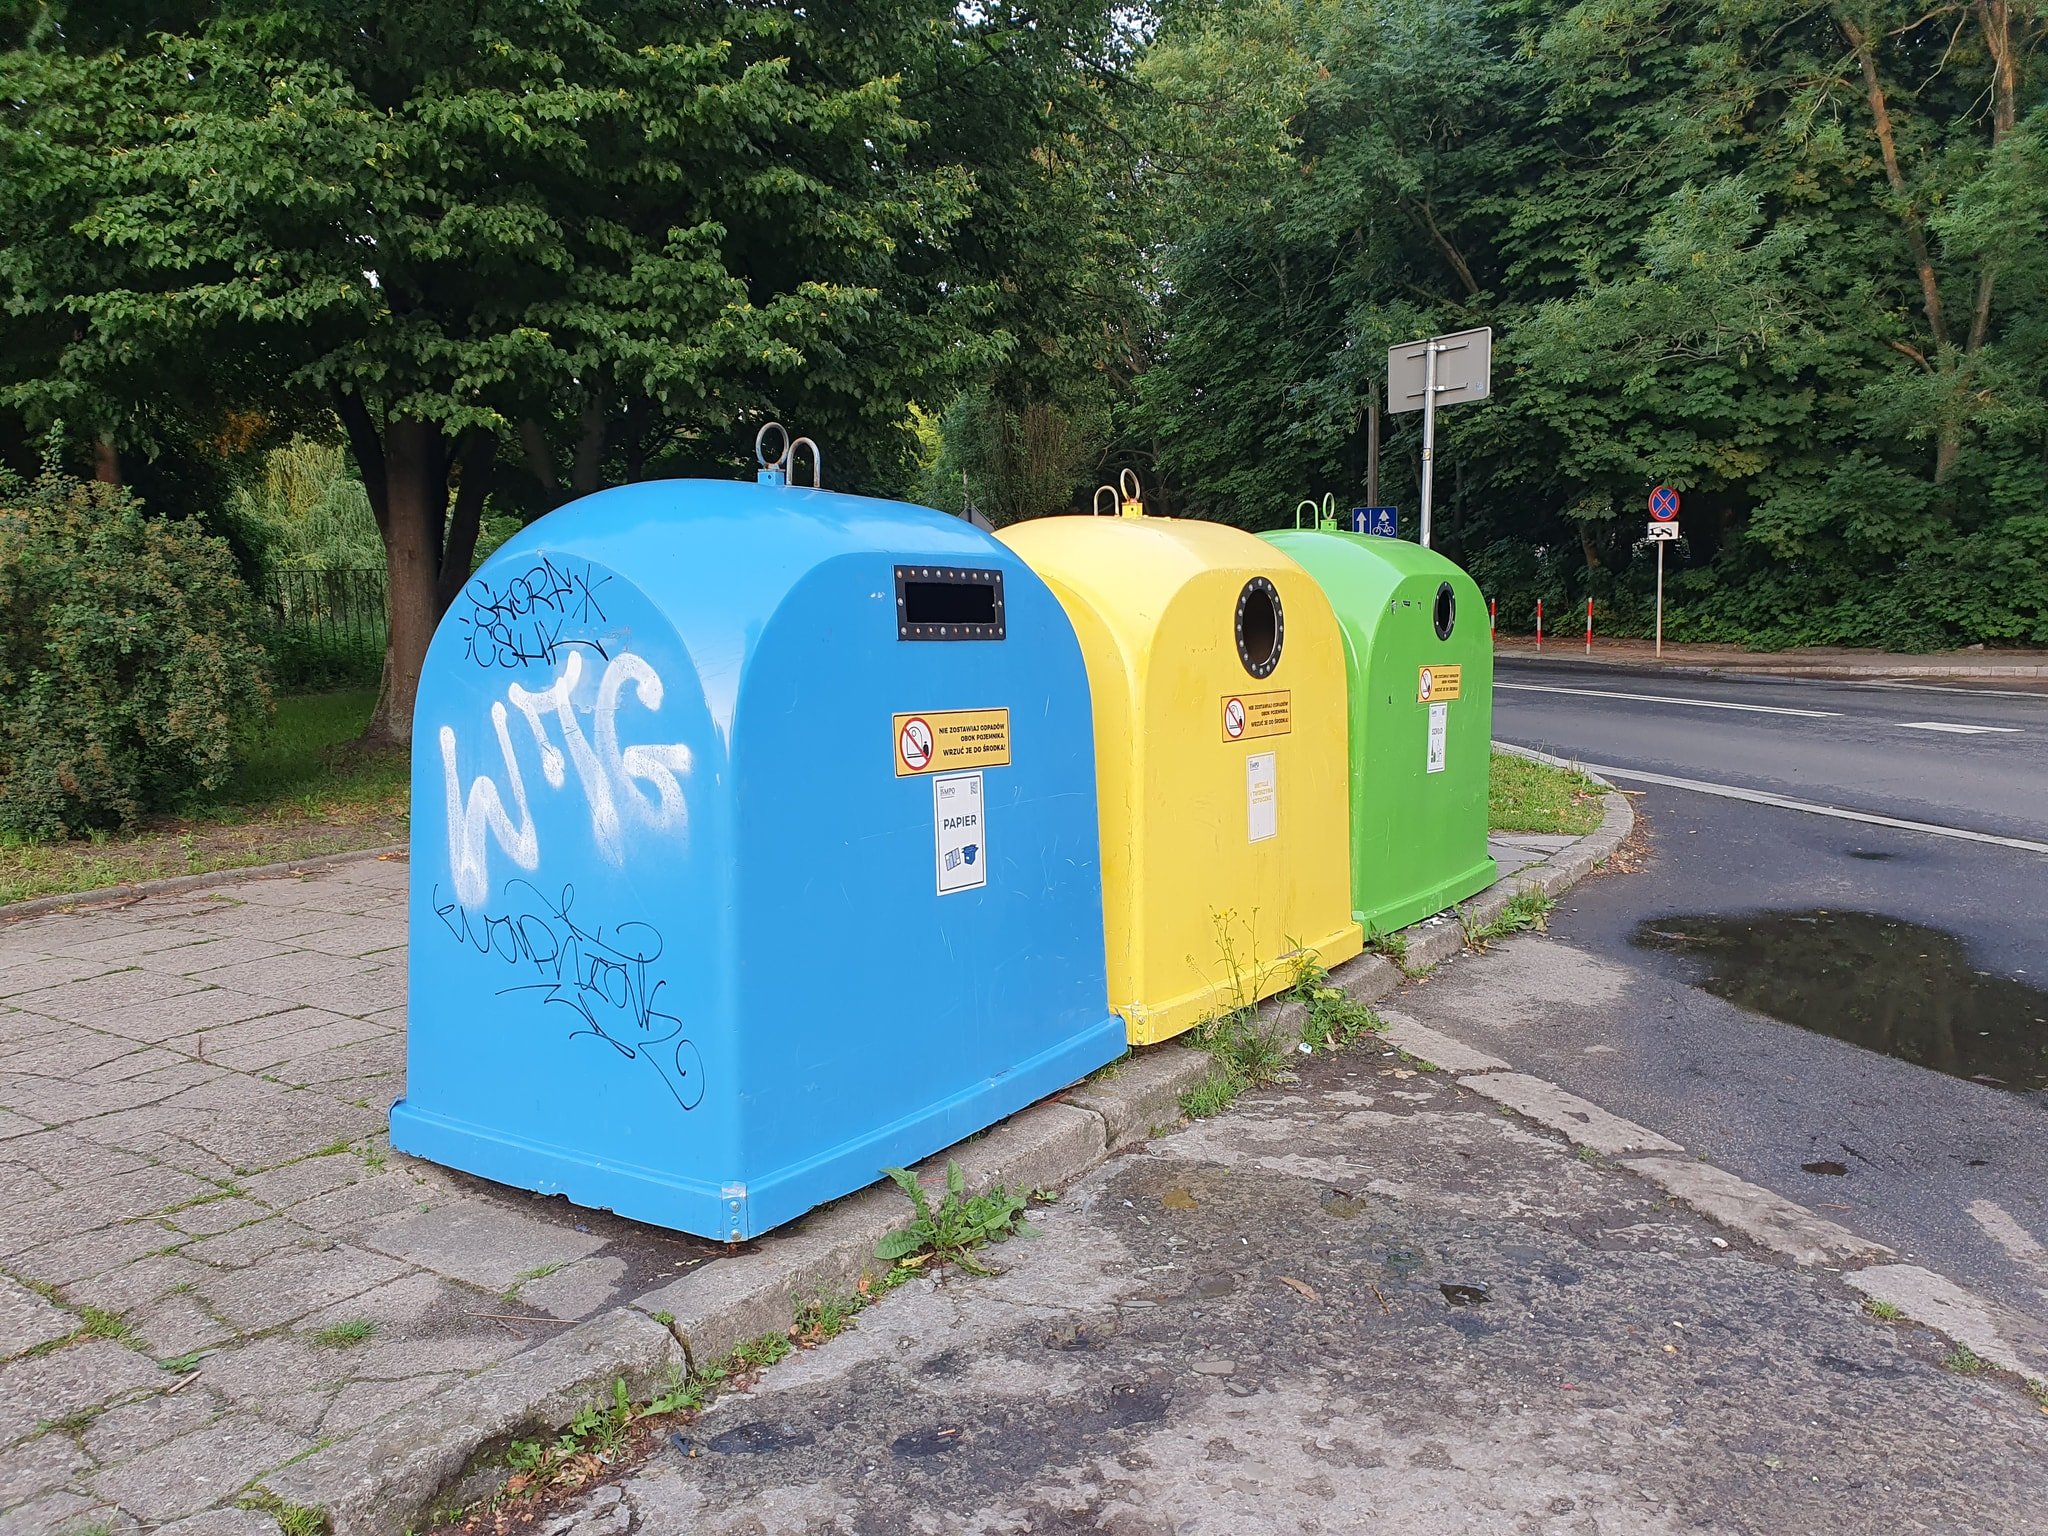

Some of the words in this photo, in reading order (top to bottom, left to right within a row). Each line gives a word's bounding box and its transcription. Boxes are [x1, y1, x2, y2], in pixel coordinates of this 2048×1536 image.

[949, 725, 979, 733] ZOSTAWIAJ
[980, 723, 1004, 731] ODPADÓW
[960, 734, 975, 742] OBOK
[943, 747, 964, 757] WRZUĆ
[965, 746, 973, 754] JE
[973, 745, 981, 753] DO
[983, 744, 1006, 753] ŚRODKA!
[943, 815, 977, 830] PAPIER
